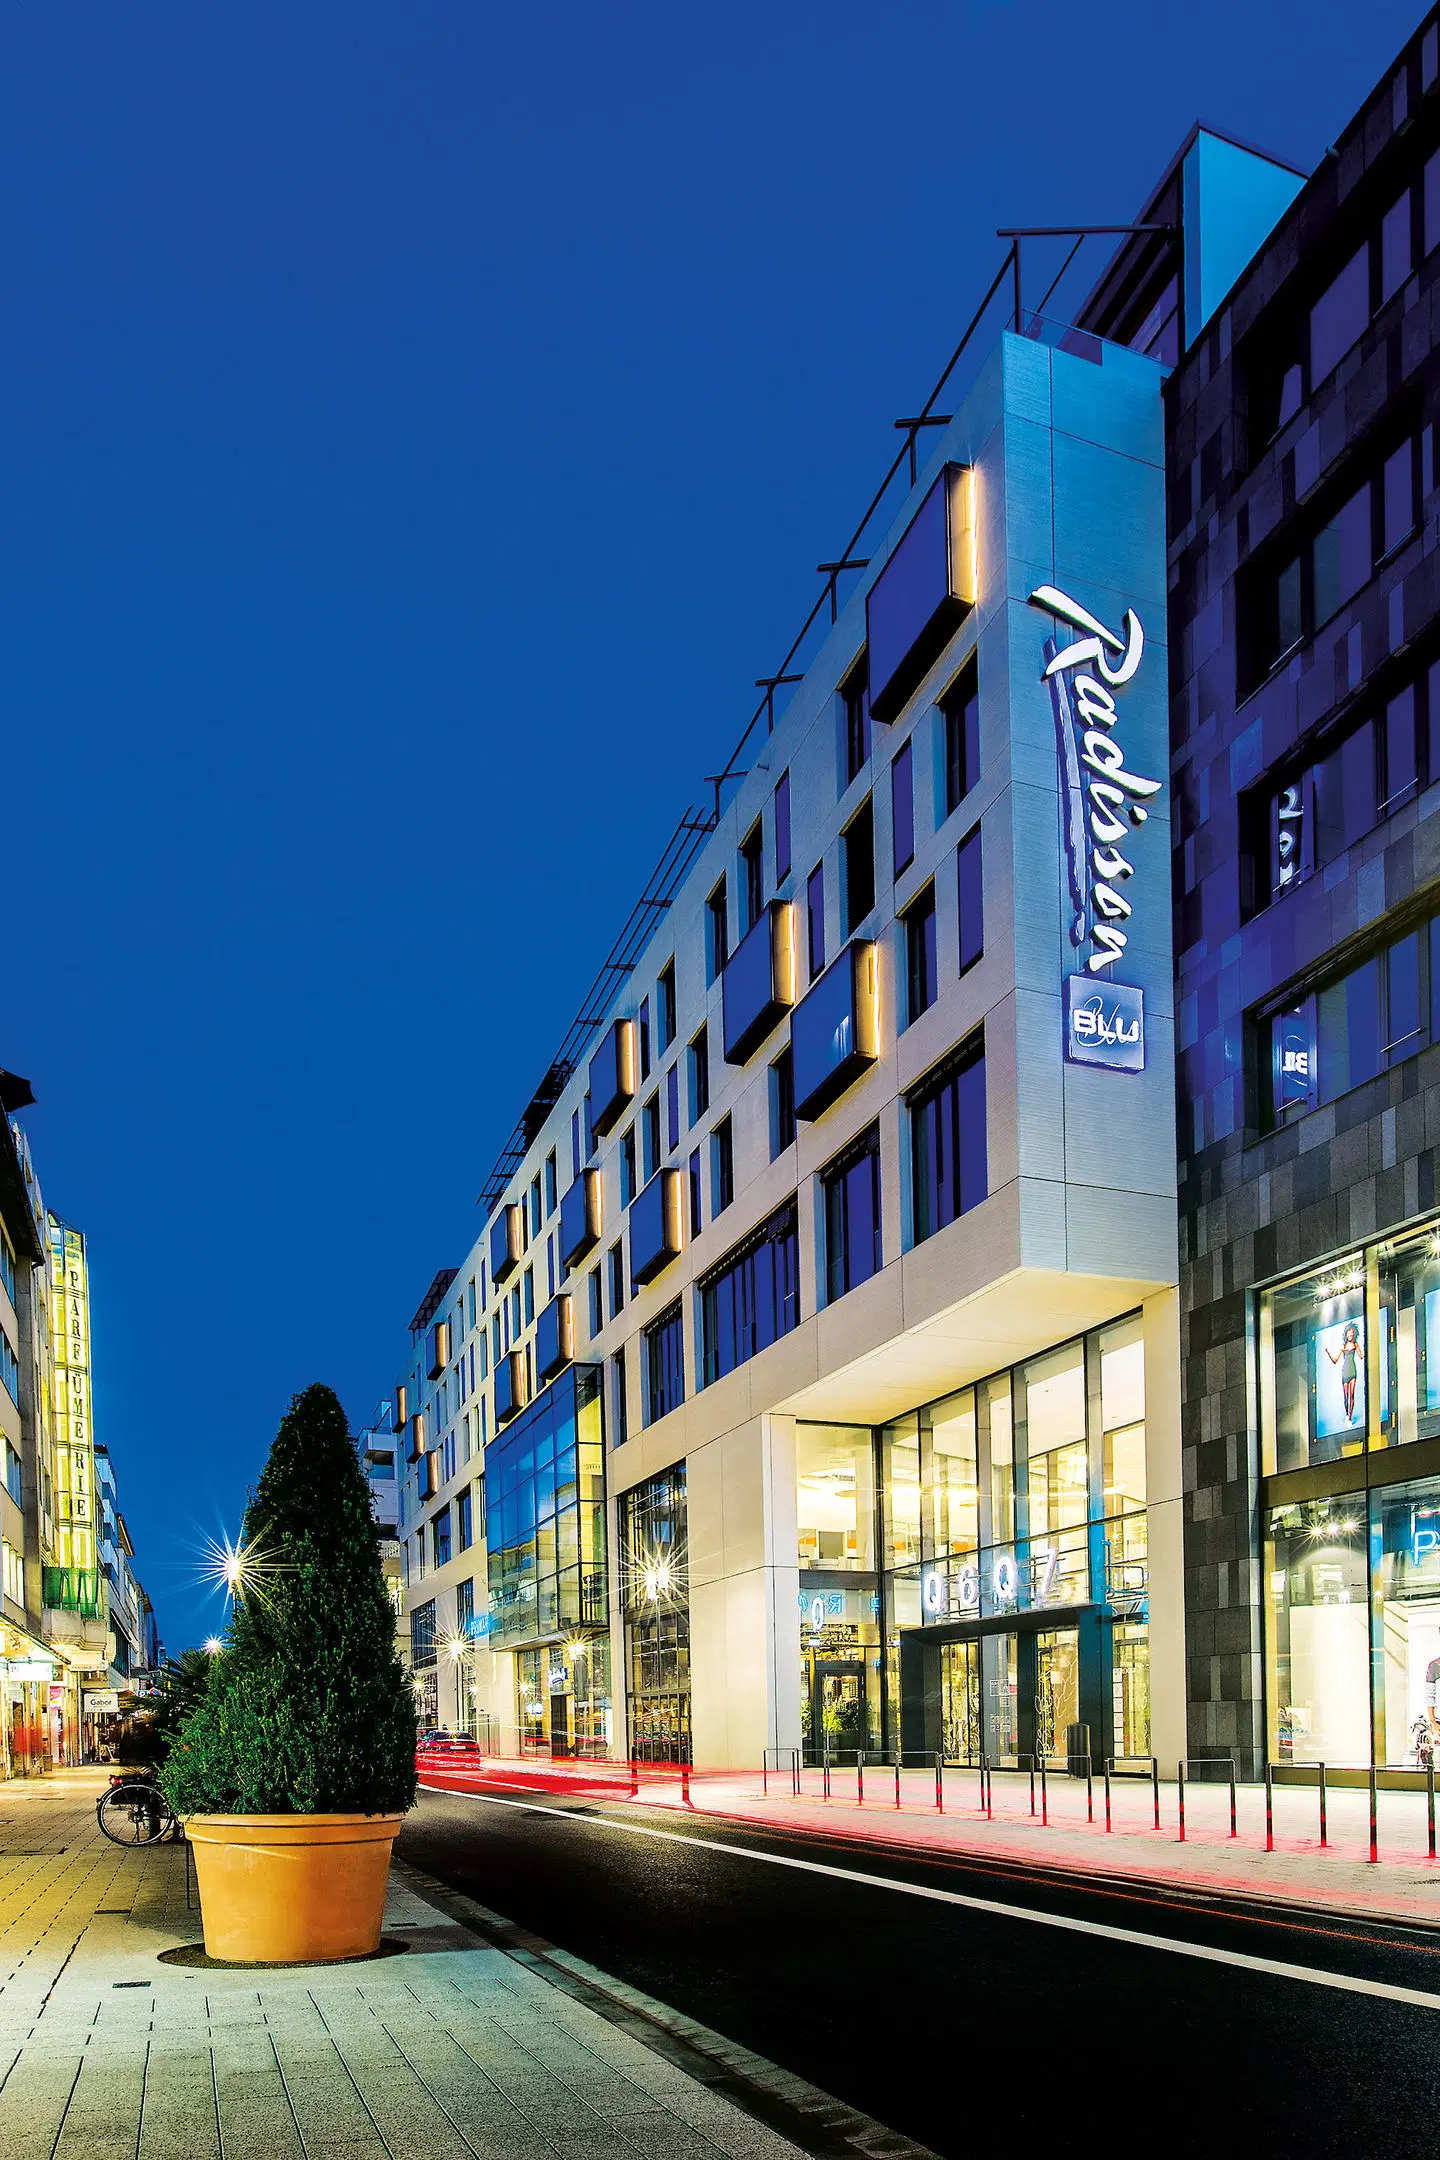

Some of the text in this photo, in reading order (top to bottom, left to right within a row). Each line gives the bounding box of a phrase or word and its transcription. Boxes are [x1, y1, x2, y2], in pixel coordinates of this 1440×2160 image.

[1029, 584, 1163, 972] Radisson
[1073, 1008, 1139, 1044] BLU
[69, 1270, 86, 1516] PARFÜMERIE
[89, 1698, 112, 1706] Gabor
